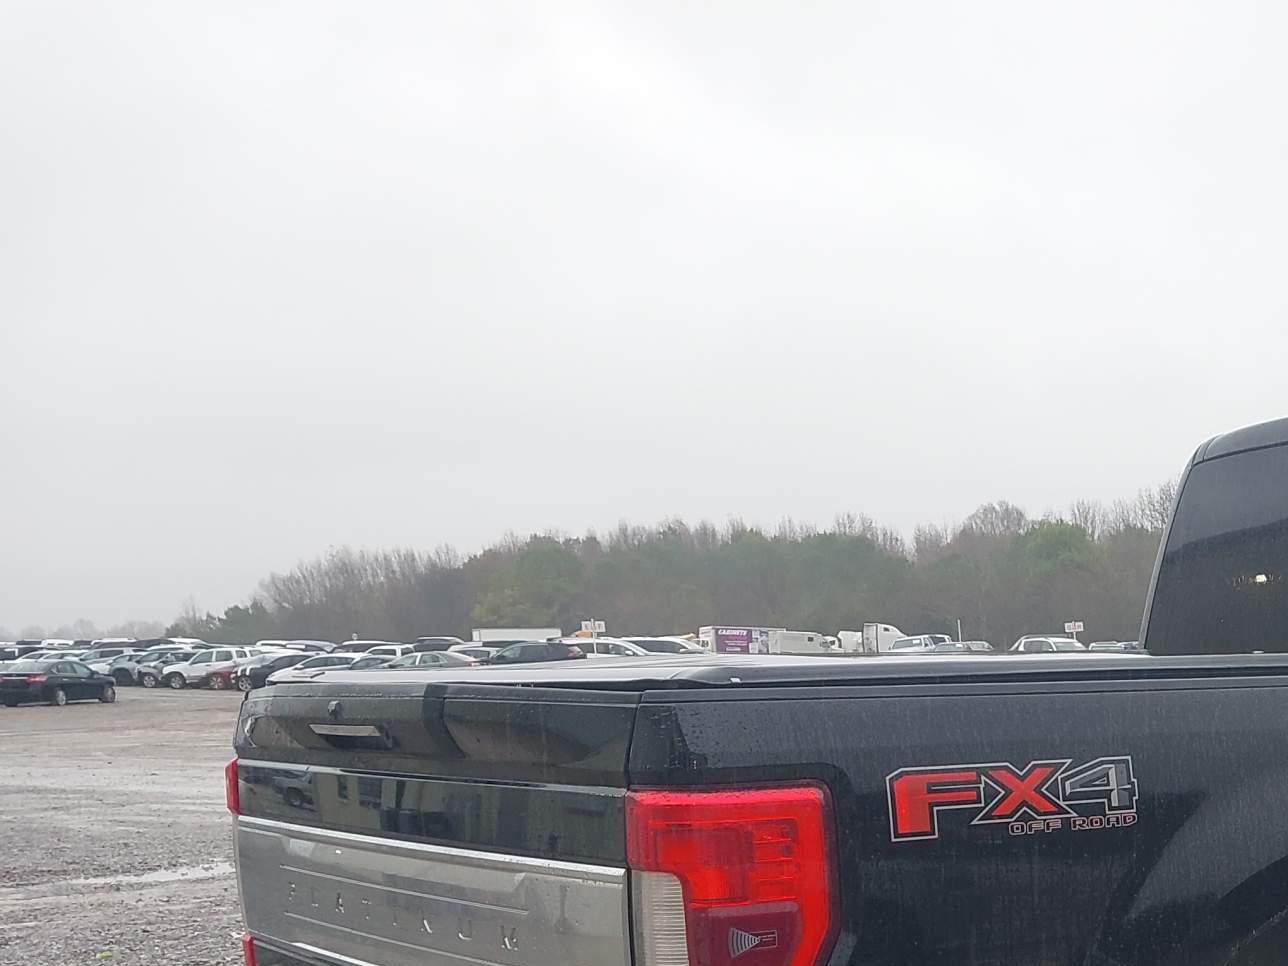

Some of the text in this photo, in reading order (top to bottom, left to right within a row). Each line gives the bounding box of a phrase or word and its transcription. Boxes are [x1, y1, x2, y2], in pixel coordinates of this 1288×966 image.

[886, 756, 1139, 842] FX4
[1008, 813, 1138, 835] OFF ROAD
